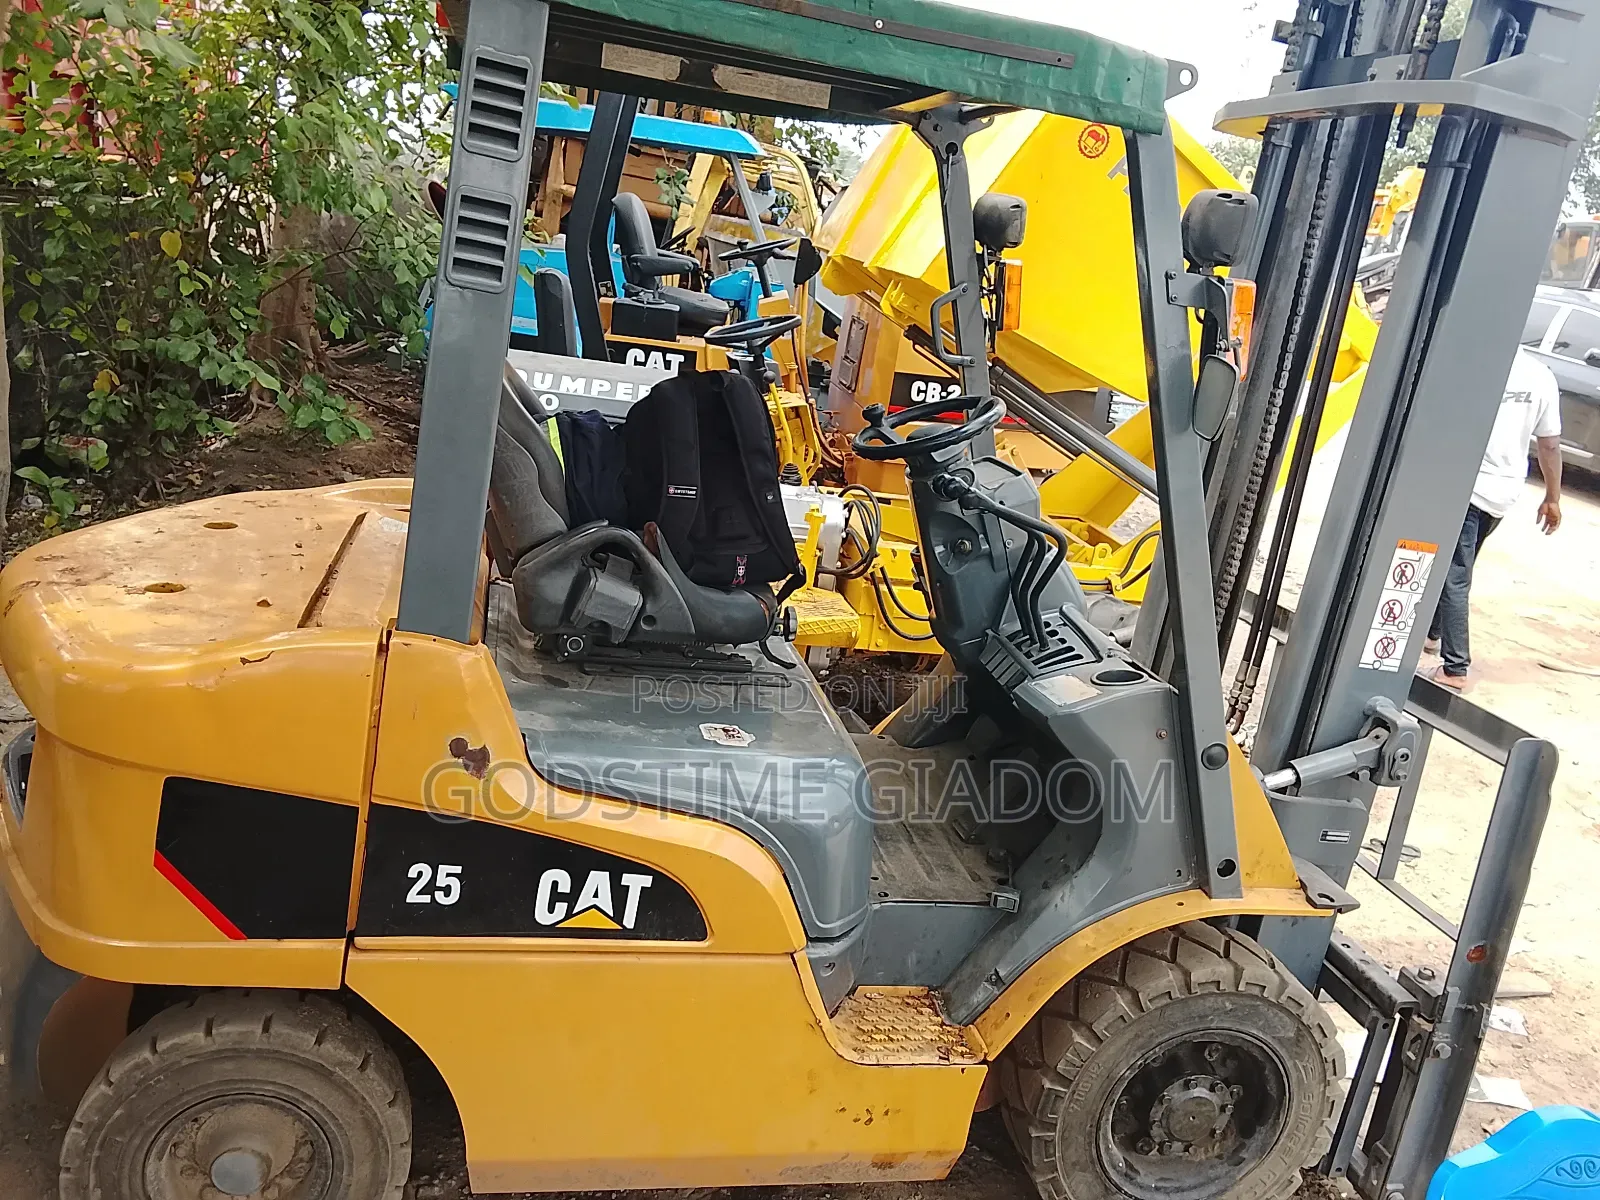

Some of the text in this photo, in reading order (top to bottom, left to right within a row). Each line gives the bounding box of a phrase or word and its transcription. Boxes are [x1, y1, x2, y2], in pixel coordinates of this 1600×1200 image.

[626, 348, 685, 372] CAT
[405, 862, 463, 906] 25
[534, 868, 653, 929] CAT
